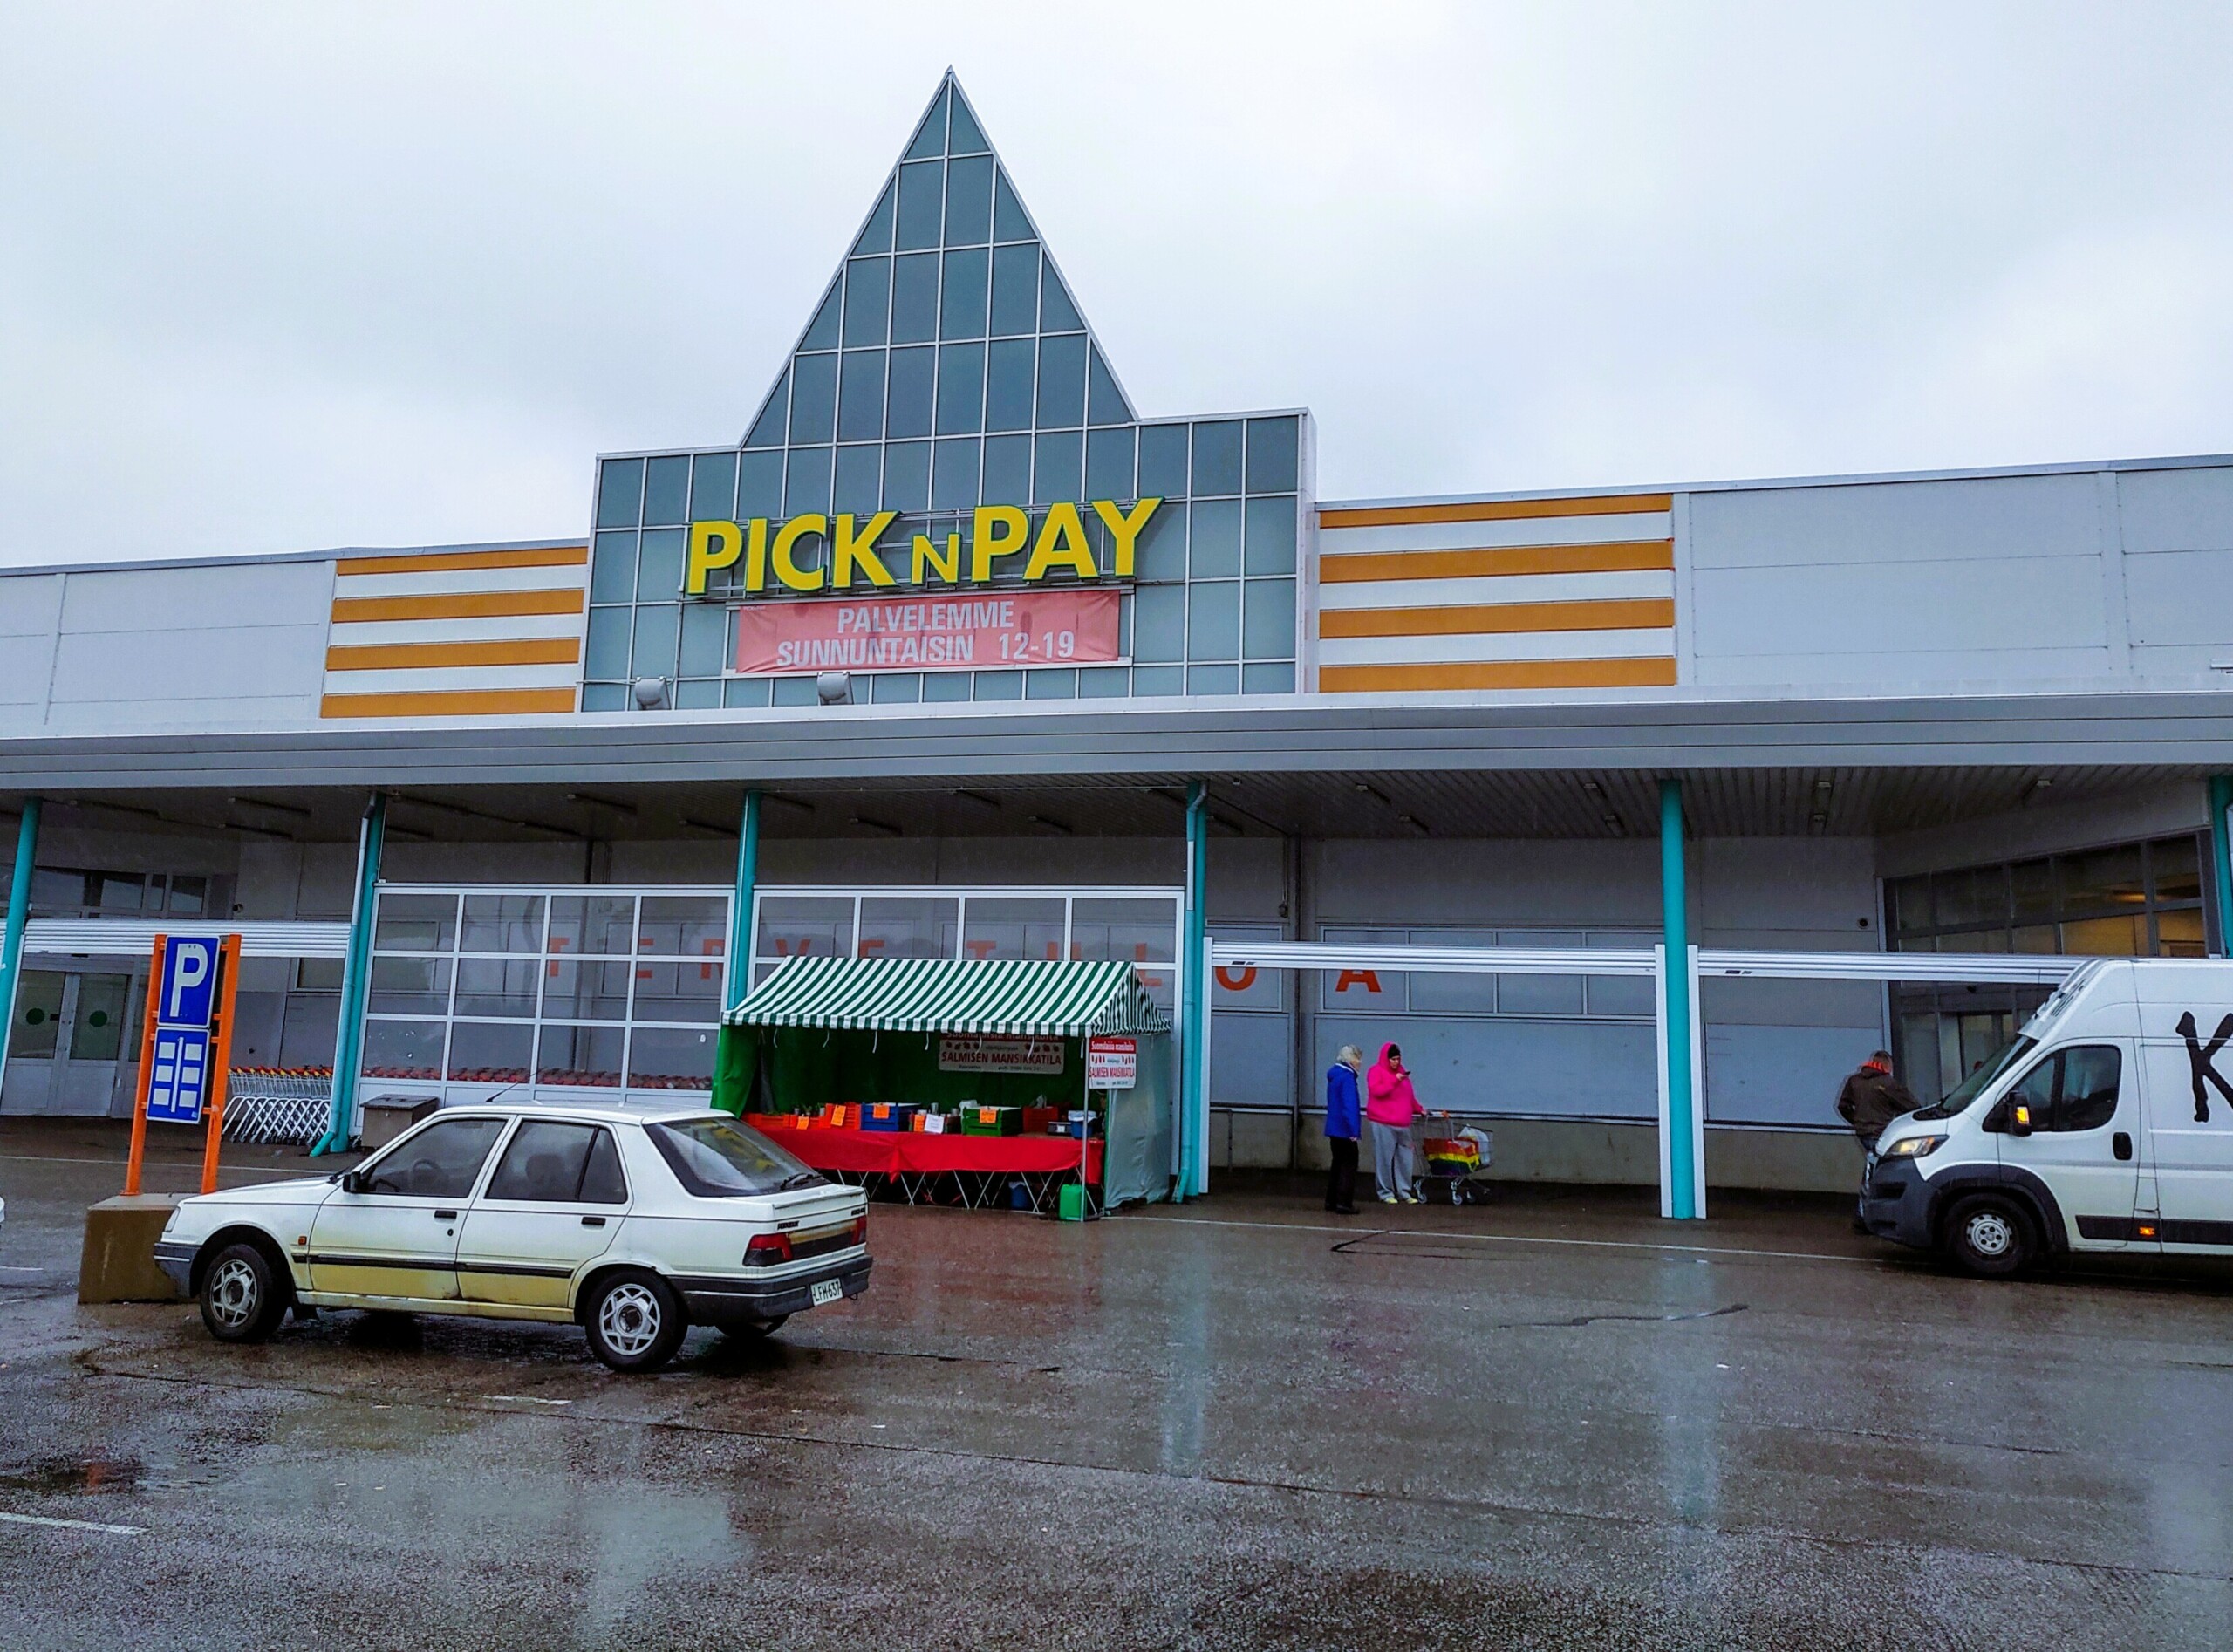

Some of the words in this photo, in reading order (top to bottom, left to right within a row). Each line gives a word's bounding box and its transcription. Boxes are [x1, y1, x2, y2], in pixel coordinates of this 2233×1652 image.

[687, 510, 900, 595] PICK
[911, 533, 961, 585] N
[971, 496, 1164, 584] PAY
[837, 601, 1014, 633] PALVELEMME
[777, 635, 973, 666] SUNNUNTAISIN
[999, 631, 1075, 659] 12-19
[169, 943, 208, 1018] P
[941, 1051, 988, 1063] SALMISEN
[991, 1052, 1062, 1065] MANSIKKATILA
